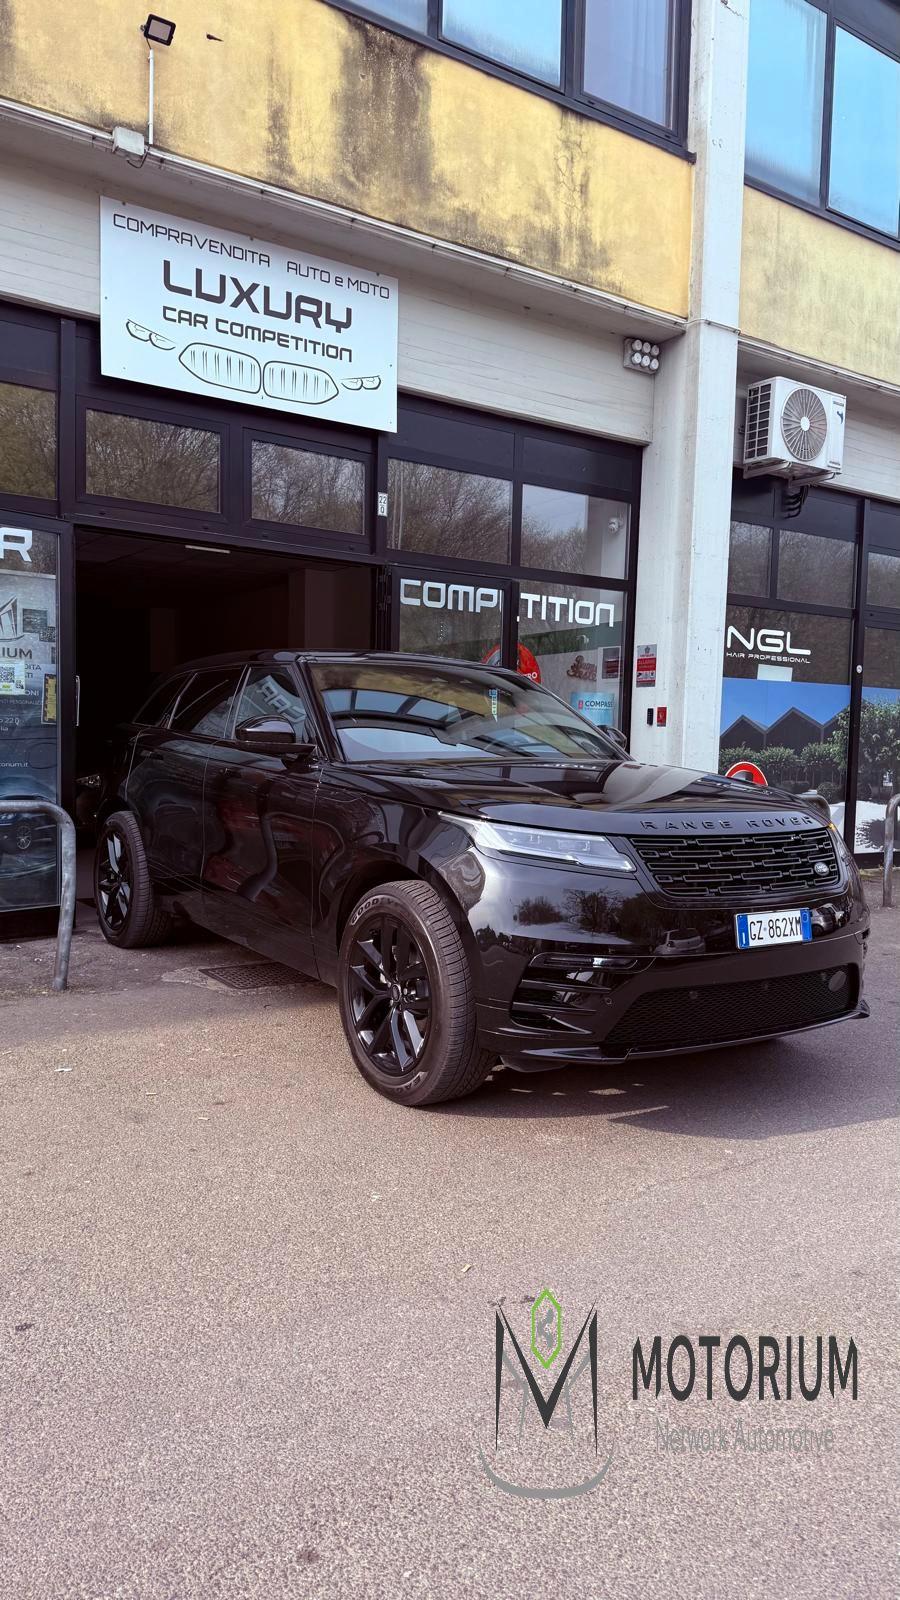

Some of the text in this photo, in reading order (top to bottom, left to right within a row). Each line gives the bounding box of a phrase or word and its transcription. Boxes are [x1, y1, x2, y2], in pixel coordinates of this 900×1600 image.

[113, 213, 390, 299] COMPRAVENDITA AUTO e MOTO
[163, 260, 352, 334] LUXURY
[163, 305, 352, 363] CAR COMPETITION
[726, 625, 812, 656] NGL
[748, 653, 812, 664] PROFESSIONAL
[640, 815, 815, 830] RANGE ROVER
[749, 920, 764, 941] GZ
